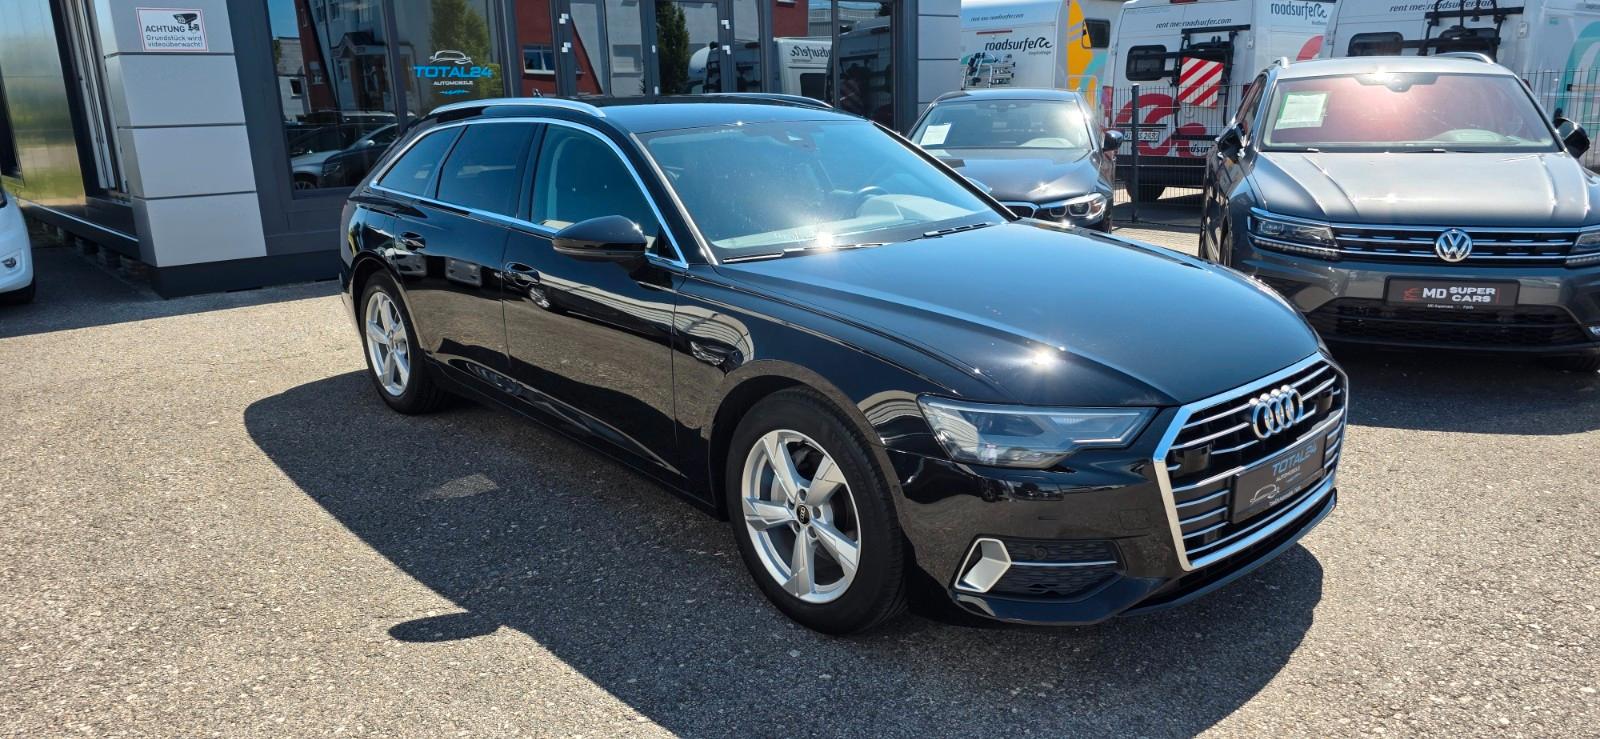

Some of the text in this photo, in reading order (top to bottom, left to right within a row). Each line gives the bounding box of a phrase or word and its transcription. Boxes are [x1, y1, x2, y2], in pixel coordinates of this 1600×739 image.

[1271, 1, 1327, 20] roadsurfer
[145, 25, 186, 33] ACHTUNG
[1182, 18, 1232, 27] roadsurfer.com
[985, 37, 1052, 52] roadsurfer
[414, 65, 493, 78] TOTAL24
[1422, 286, 1496, 299] MD SUPER
[1451, 294, 1491, 303] CARS
[1272, 441, 1317, 477] TOTAL24
